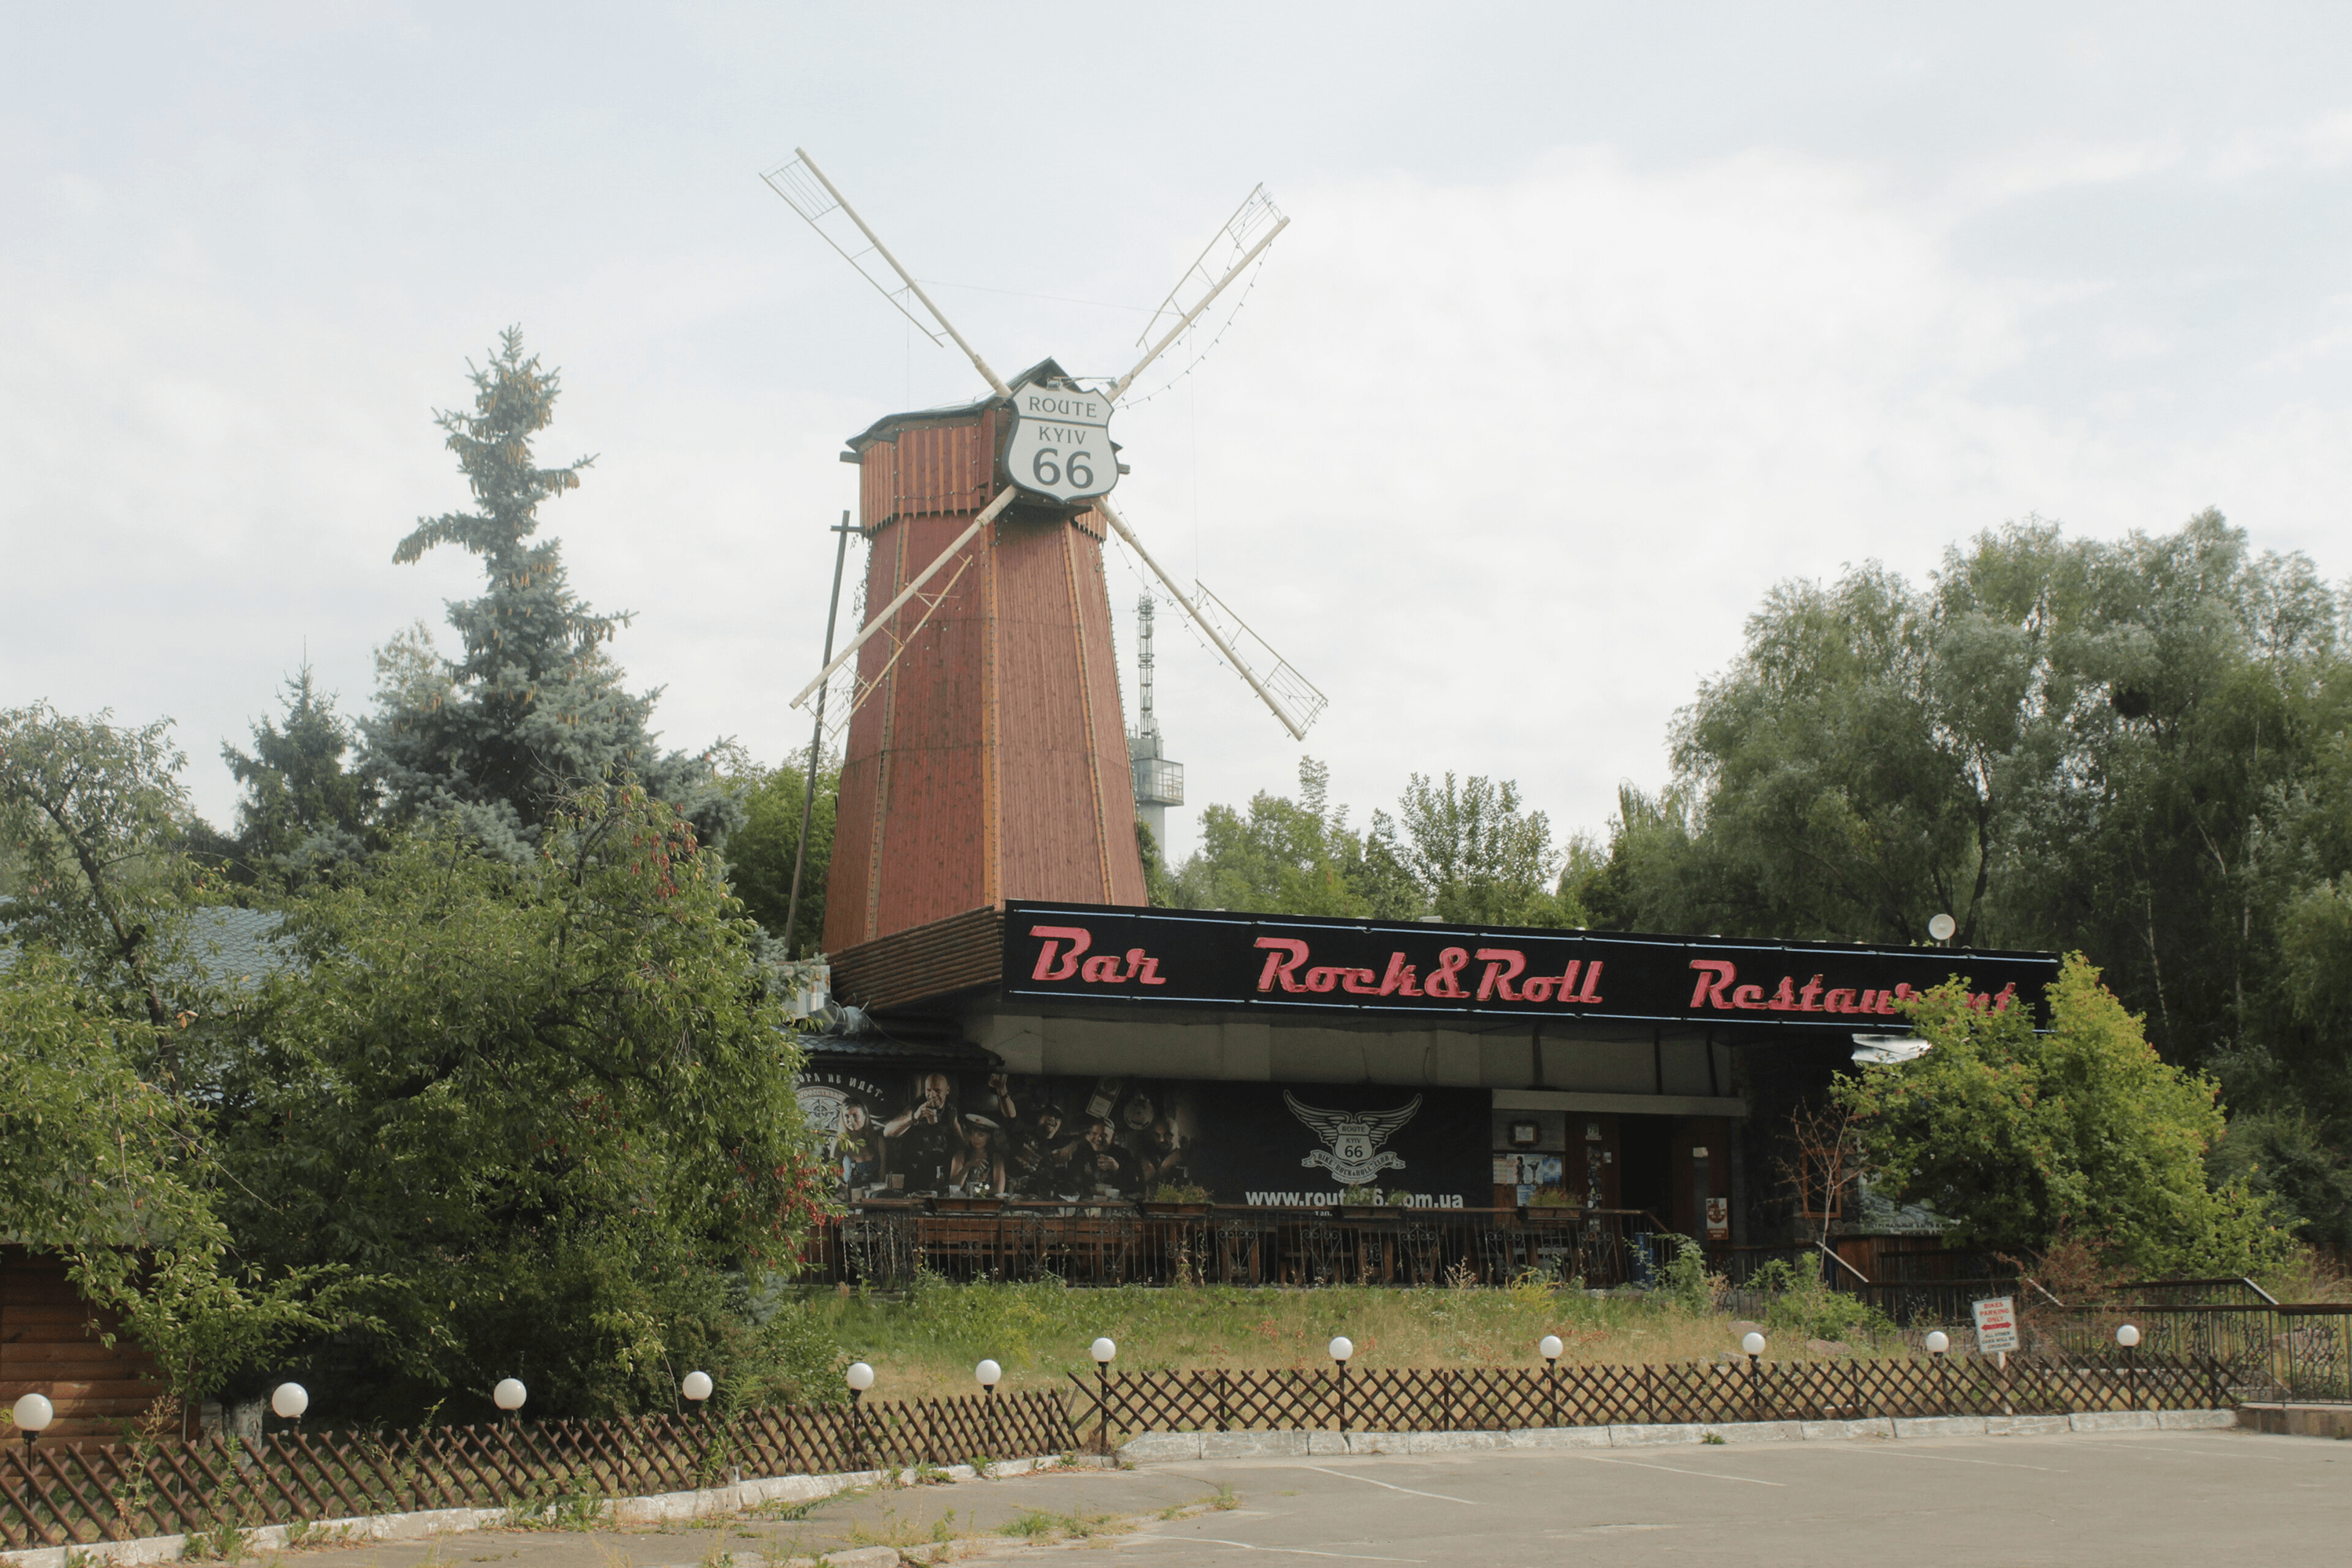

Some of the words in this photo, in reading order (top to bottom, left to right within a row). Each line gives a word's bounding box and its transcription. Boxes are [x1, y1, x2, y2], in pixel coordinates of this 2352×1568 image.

[1029, 397, 1097, 417] ROUTE
[1039, 427, 1086, 445] KYIV
[1033, 448, 1094, 489] 66
[1028, 925, 1167, 985] Bar
[1254, 936, 1604, 1004] Rock&Roll
[1345, 1145, 1363, 1158] 66
